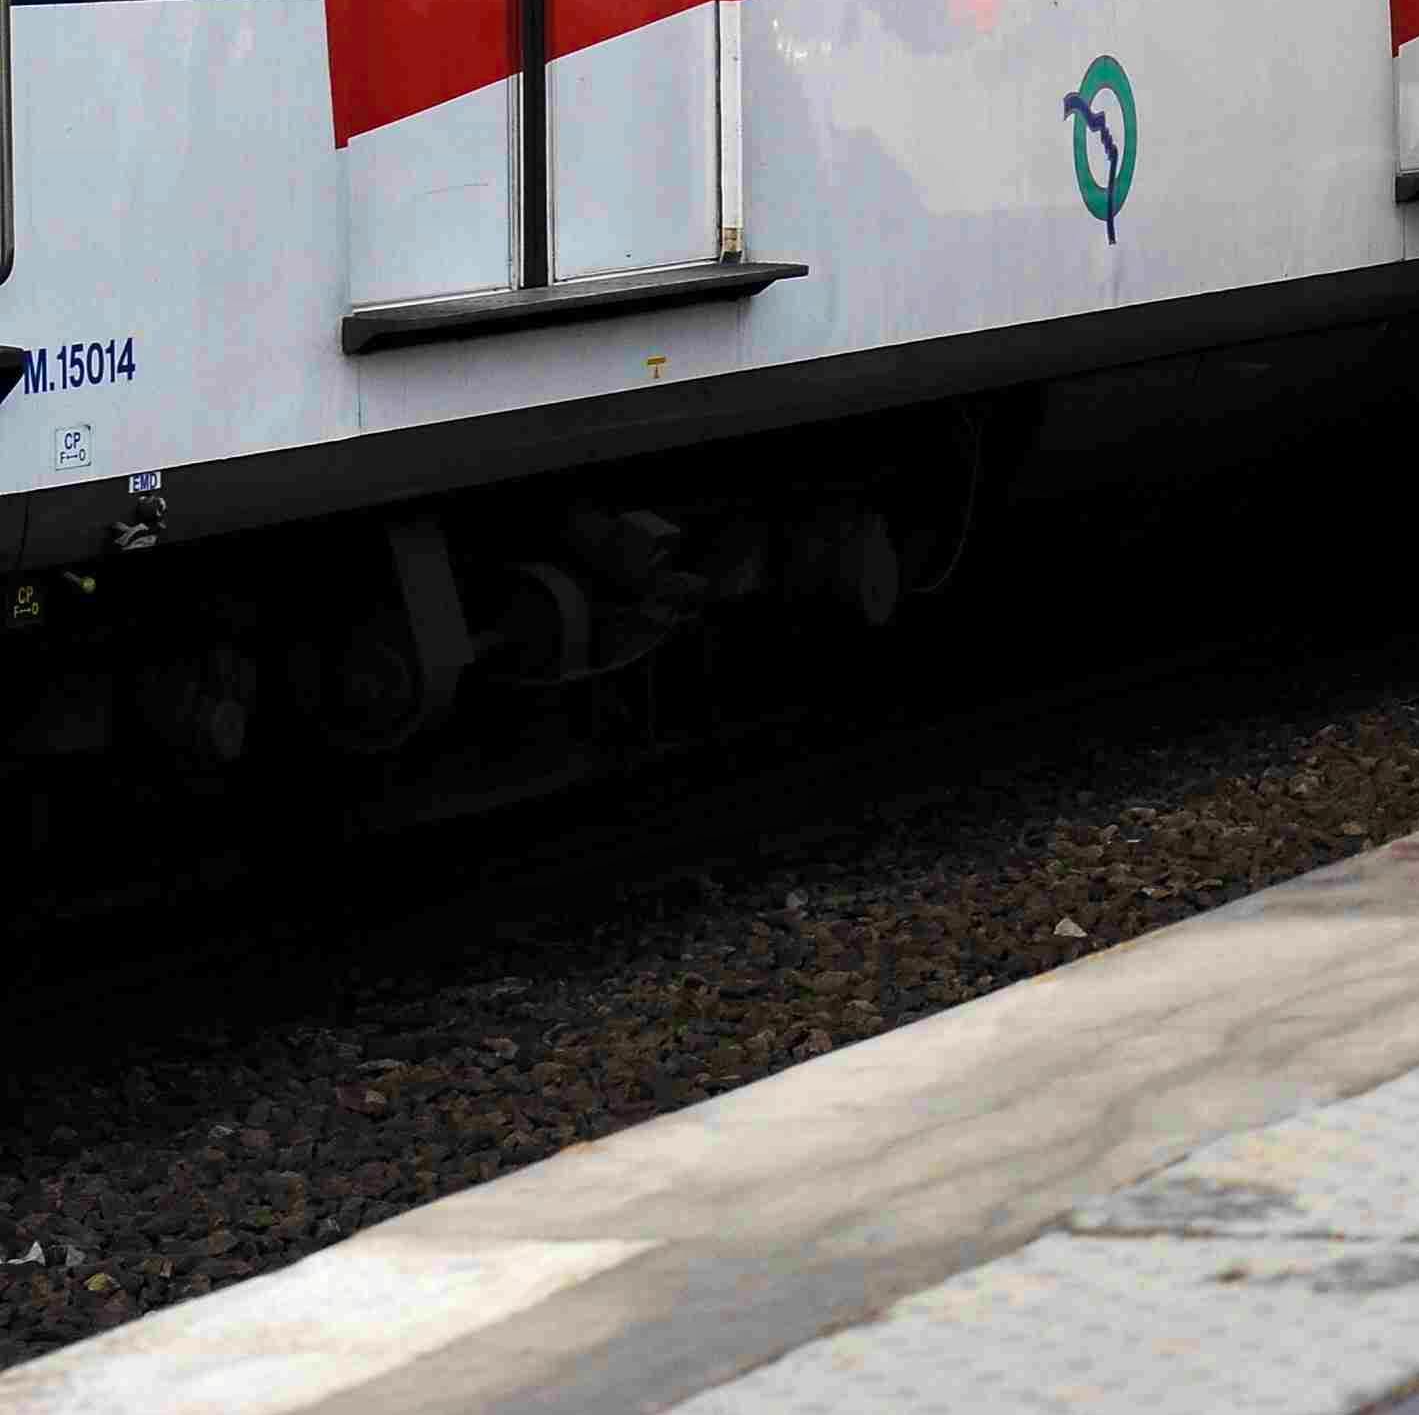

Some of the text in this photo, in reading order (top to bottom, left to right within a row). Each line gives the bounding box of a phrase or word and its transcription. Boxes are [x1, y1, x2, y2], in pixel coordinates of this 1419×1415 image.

[23, 338, 136, 394] M.15014
[65, 433, 80, 449] CP
[133, 475, 158, 490] EMD
